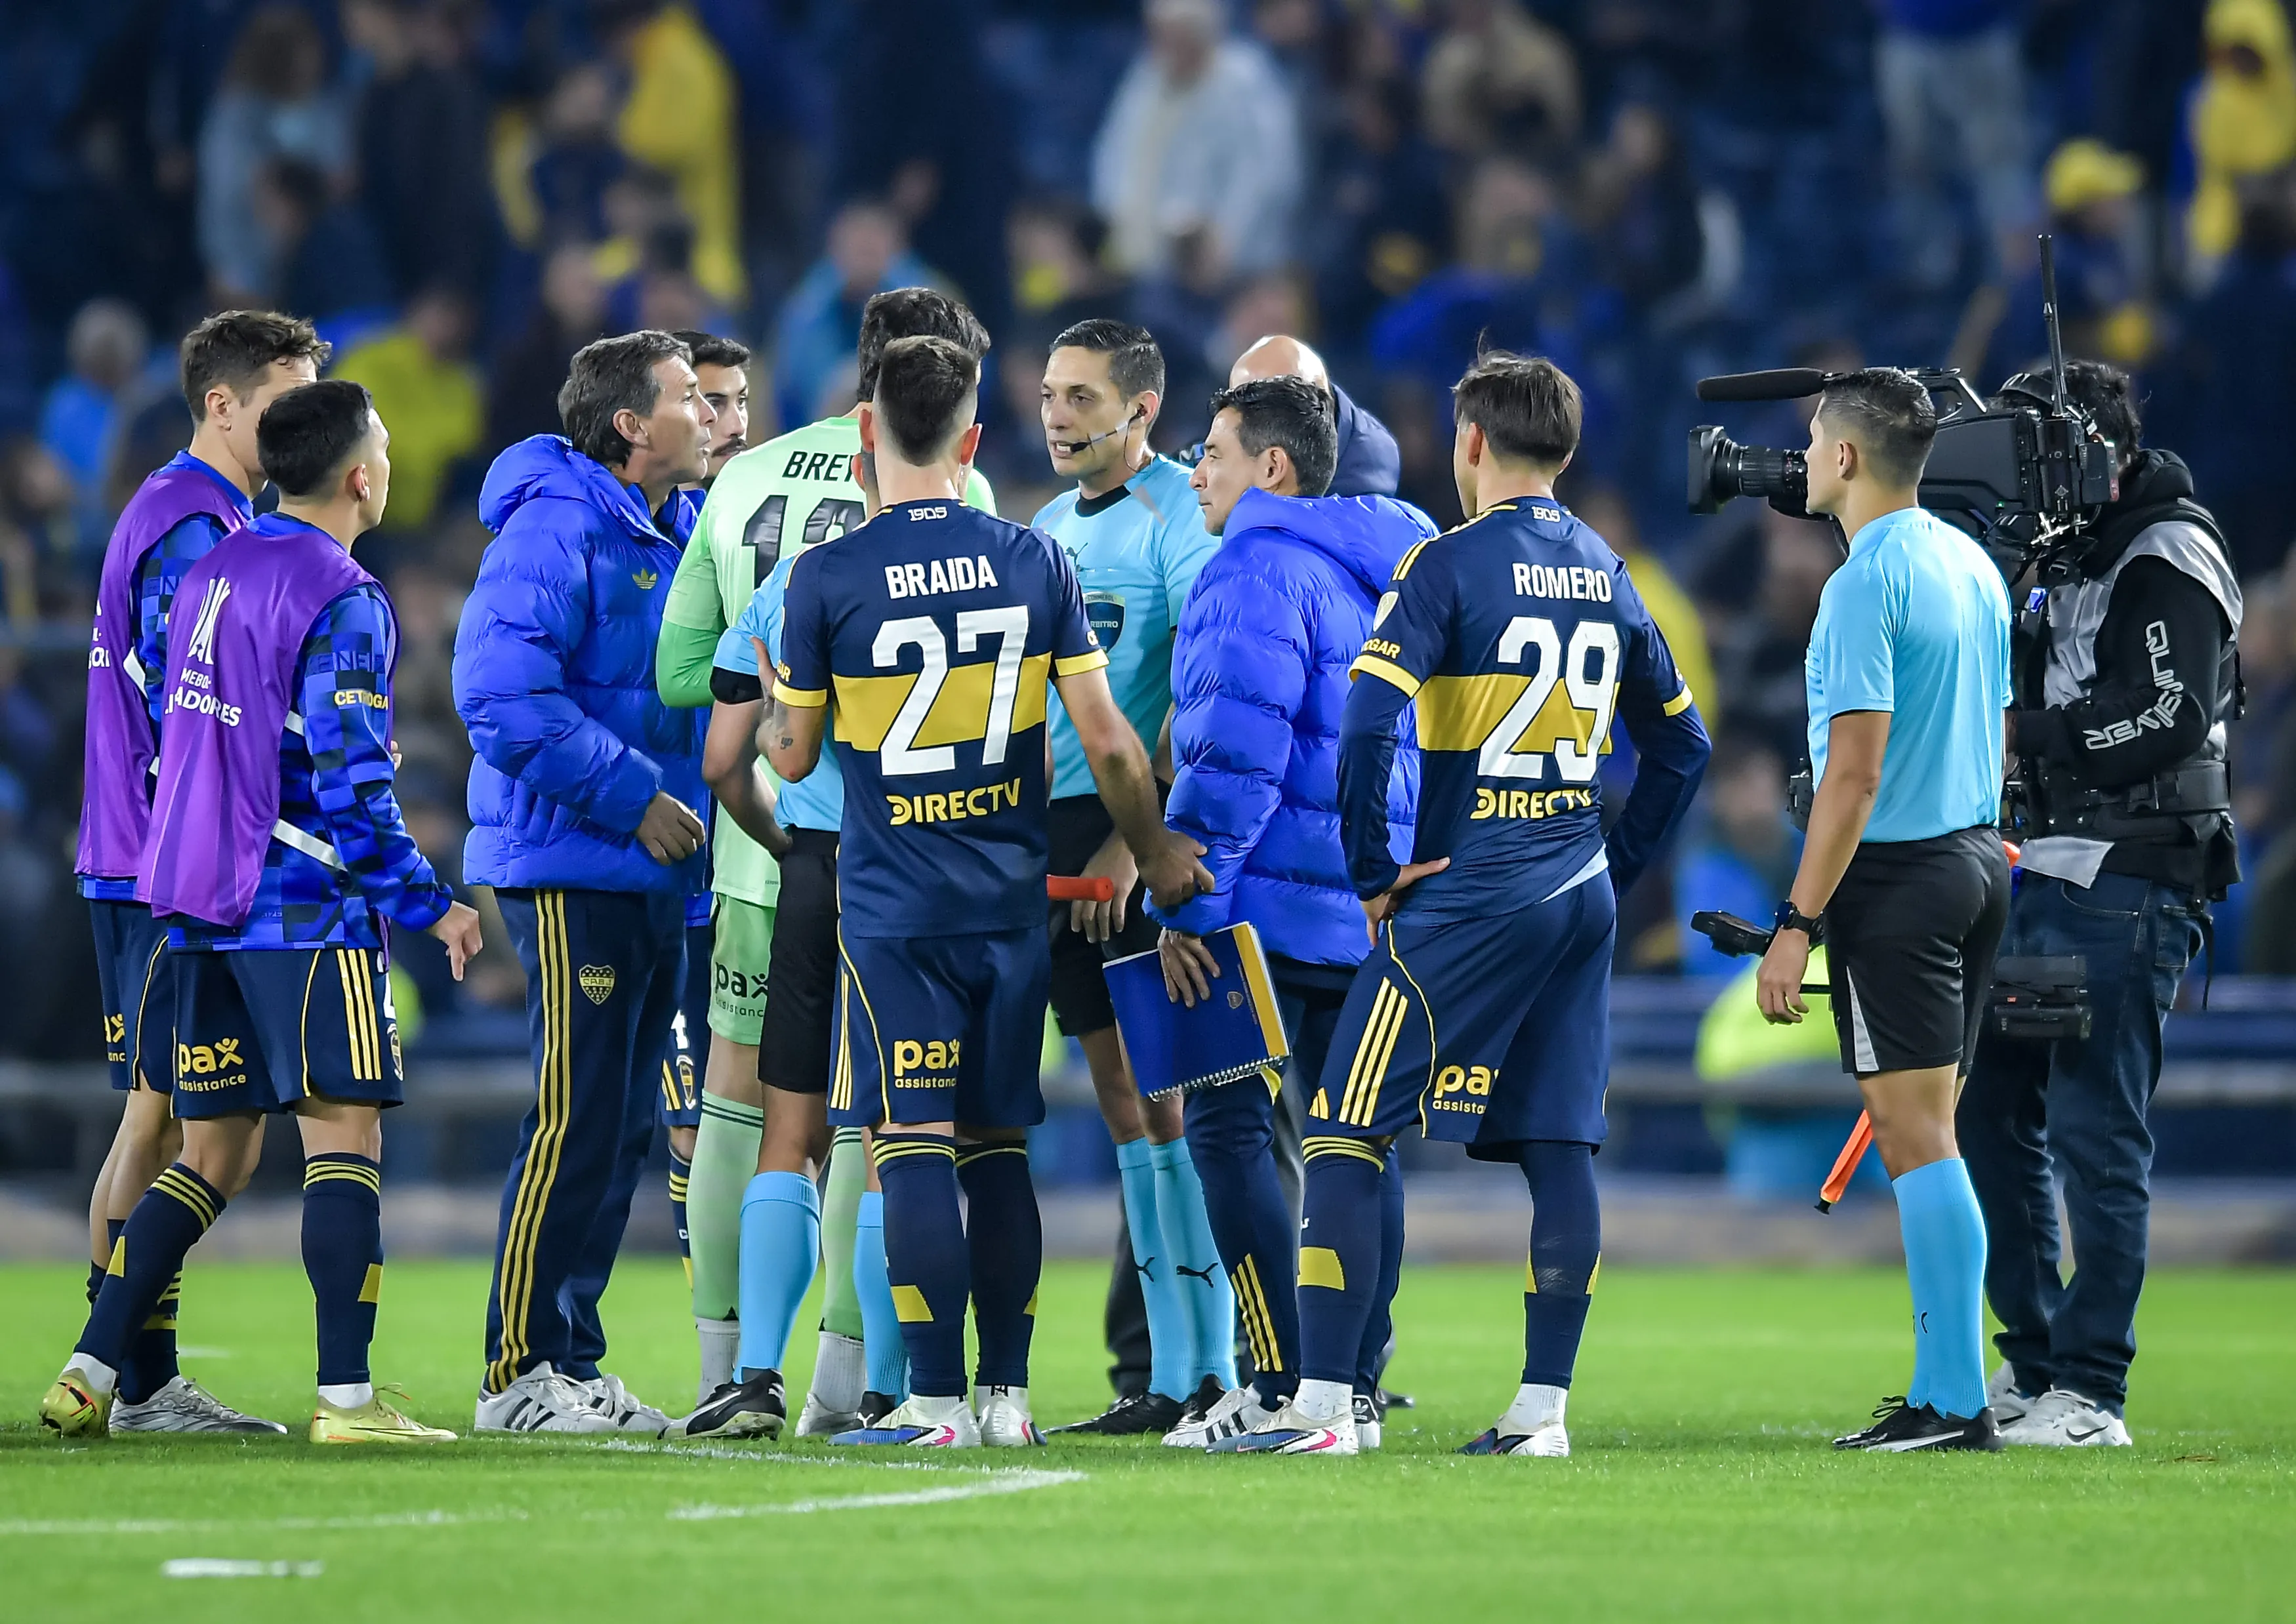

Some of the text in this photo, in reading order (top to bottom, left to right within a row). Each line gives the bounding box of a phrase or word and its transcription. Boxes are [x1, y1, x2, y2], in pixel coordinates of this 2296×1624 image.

[908, 506, 947, 521] 1905
[1532, 506, 1561, 523] 1905
[885, 555, 998, 599] BRAIDA
[1512, 563, 1612, 603] ROMERO
[872, 605, 1029, 775] 27
[1477, 617, 1619, 781] 29
[886, 778, 1020, 825] DIRECTV
[1470, 788, 1592, 819] DIRECTV
[178, 1038, 244, 1078] pax
[178, 1074, 247, 1092] assistance
[895, 1076, 957, 1088] assistanc
[1433, 1065, 1499, 1099] pa
